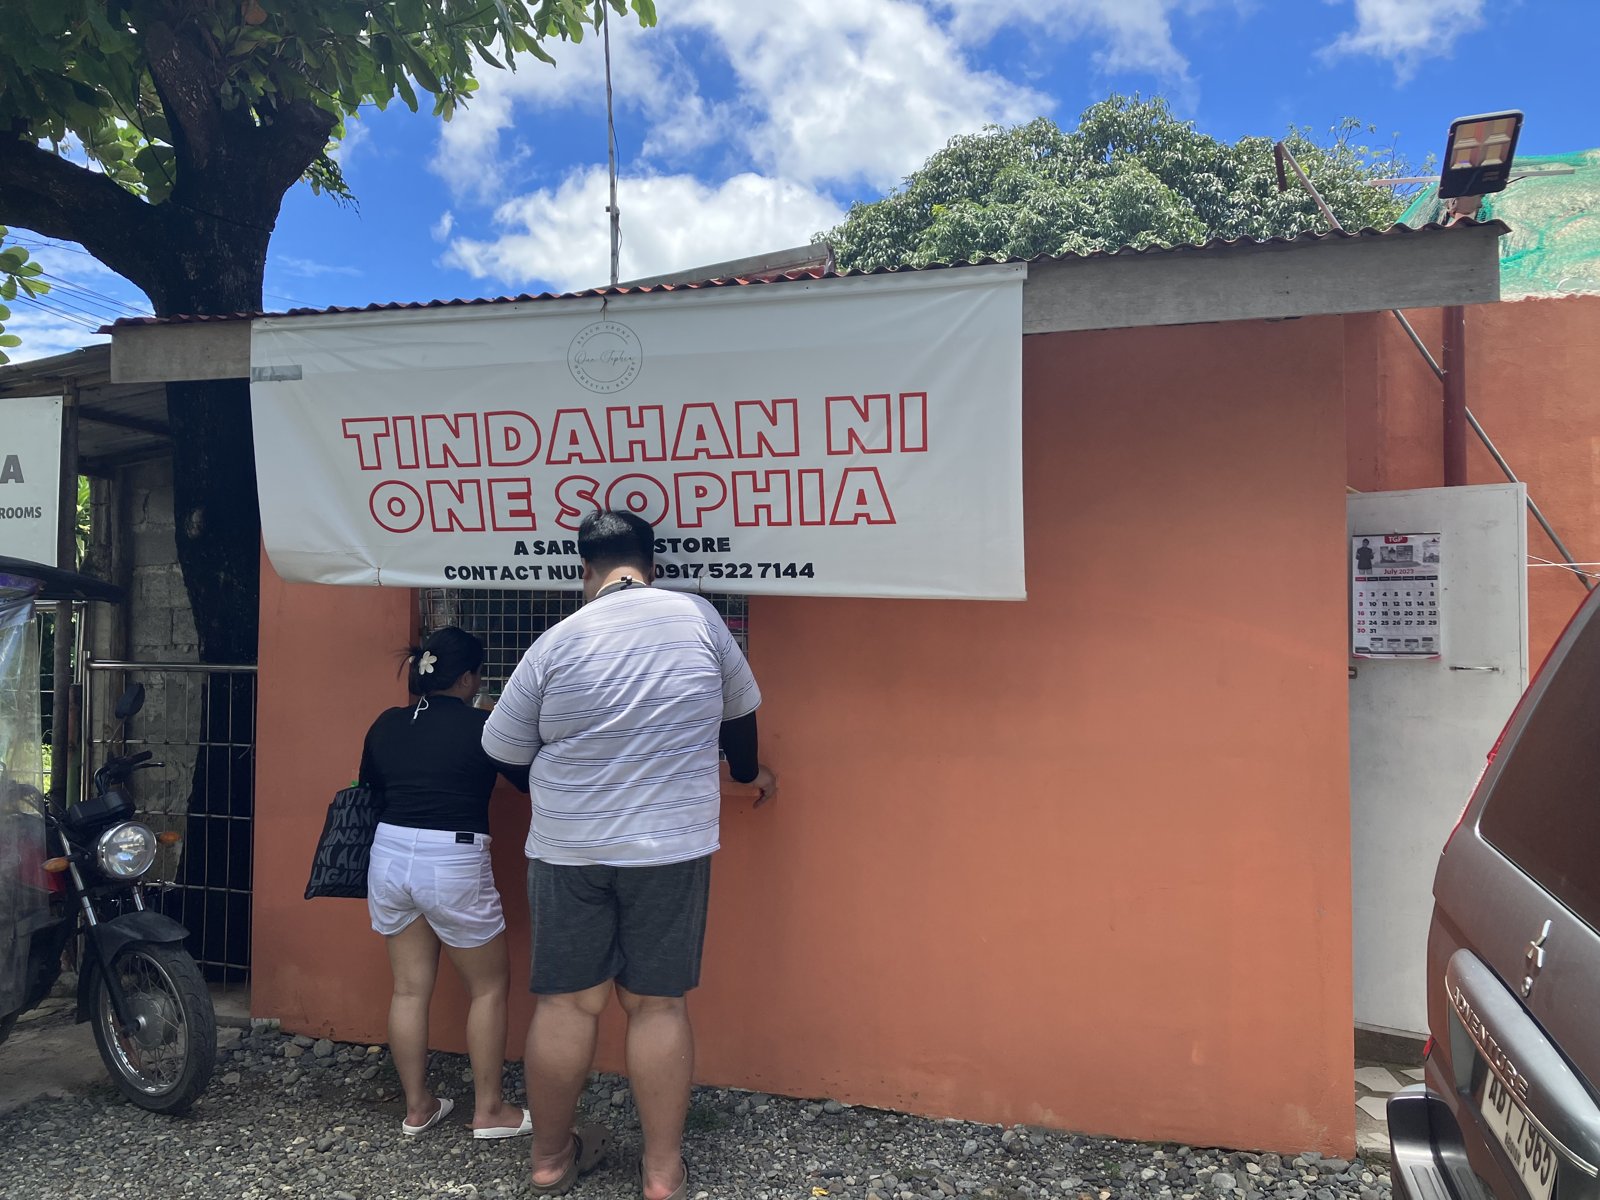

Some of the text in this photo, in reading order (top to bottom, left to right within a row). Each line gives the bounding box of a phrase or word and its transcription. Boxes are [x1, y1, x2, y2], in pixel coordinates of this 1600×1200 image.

[341, 391, 929, 471] TINDAHAN NI
[369, 466, 897, 533] ONE SOPHIA
[444, 565, 543, 581] CONTACT
[654, 563, 704, 580] 0917
[708, 562, 753, 579] 522
[757, 562, 815, 579] 7144
[513, 537, 731, 556] A SAR STORE
[1453, 985, 1530, 1100] ADVENTURE
